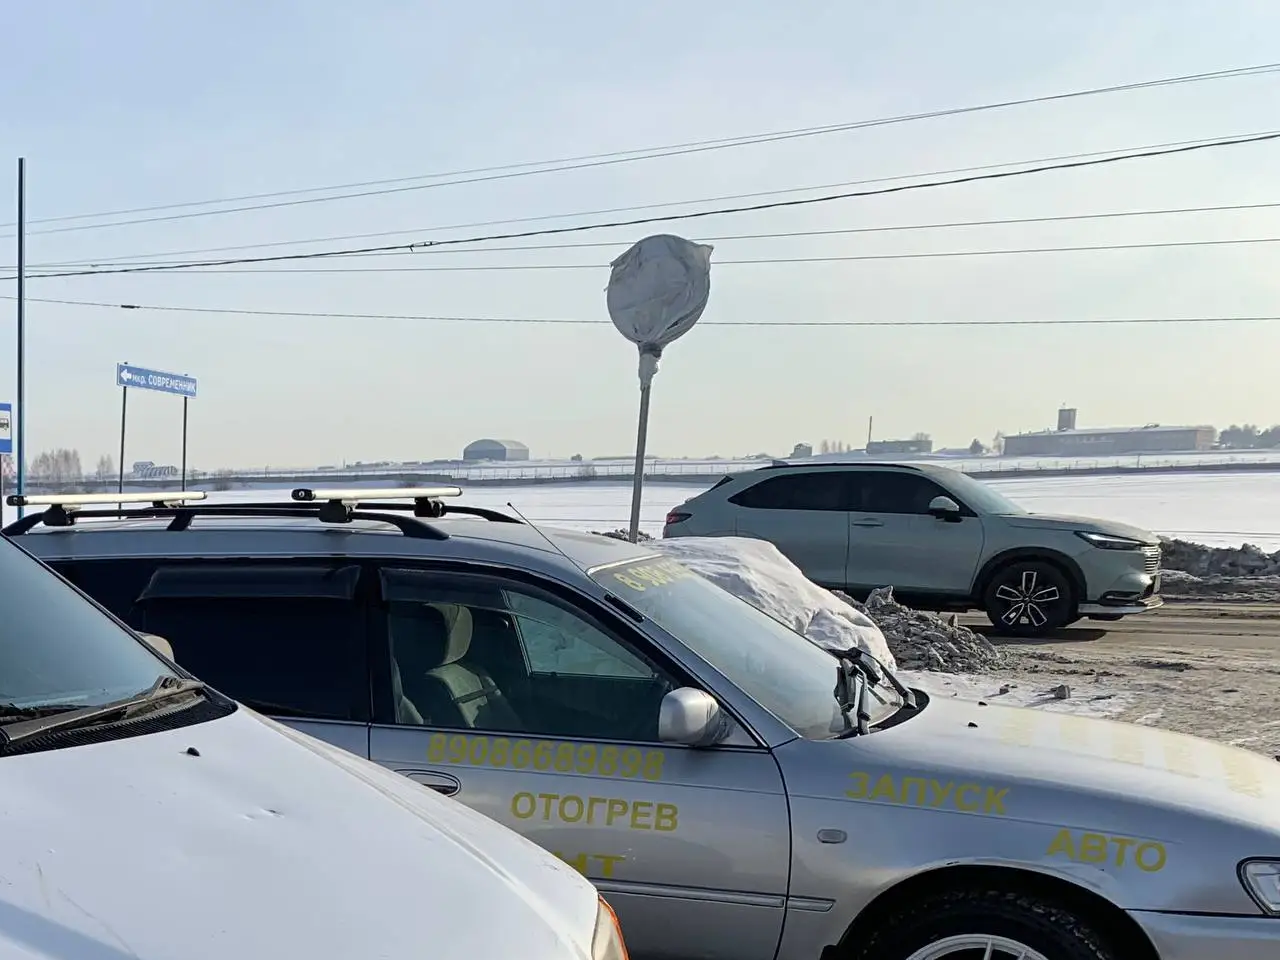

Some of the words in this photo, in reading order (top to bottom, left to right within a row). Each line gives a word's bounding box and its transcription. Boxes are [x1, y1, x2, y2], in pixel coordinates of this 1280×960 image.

[149, 374, 196, 393] СОВРЕМЕННИК
[428, 733, 664, 780] 89086689898
[511, 792, 679, 831] ОТОГРЕВ
[846, 772, 1011, 815] ЗАПУСК
[1047, 830, 1167, 872] АВТО
